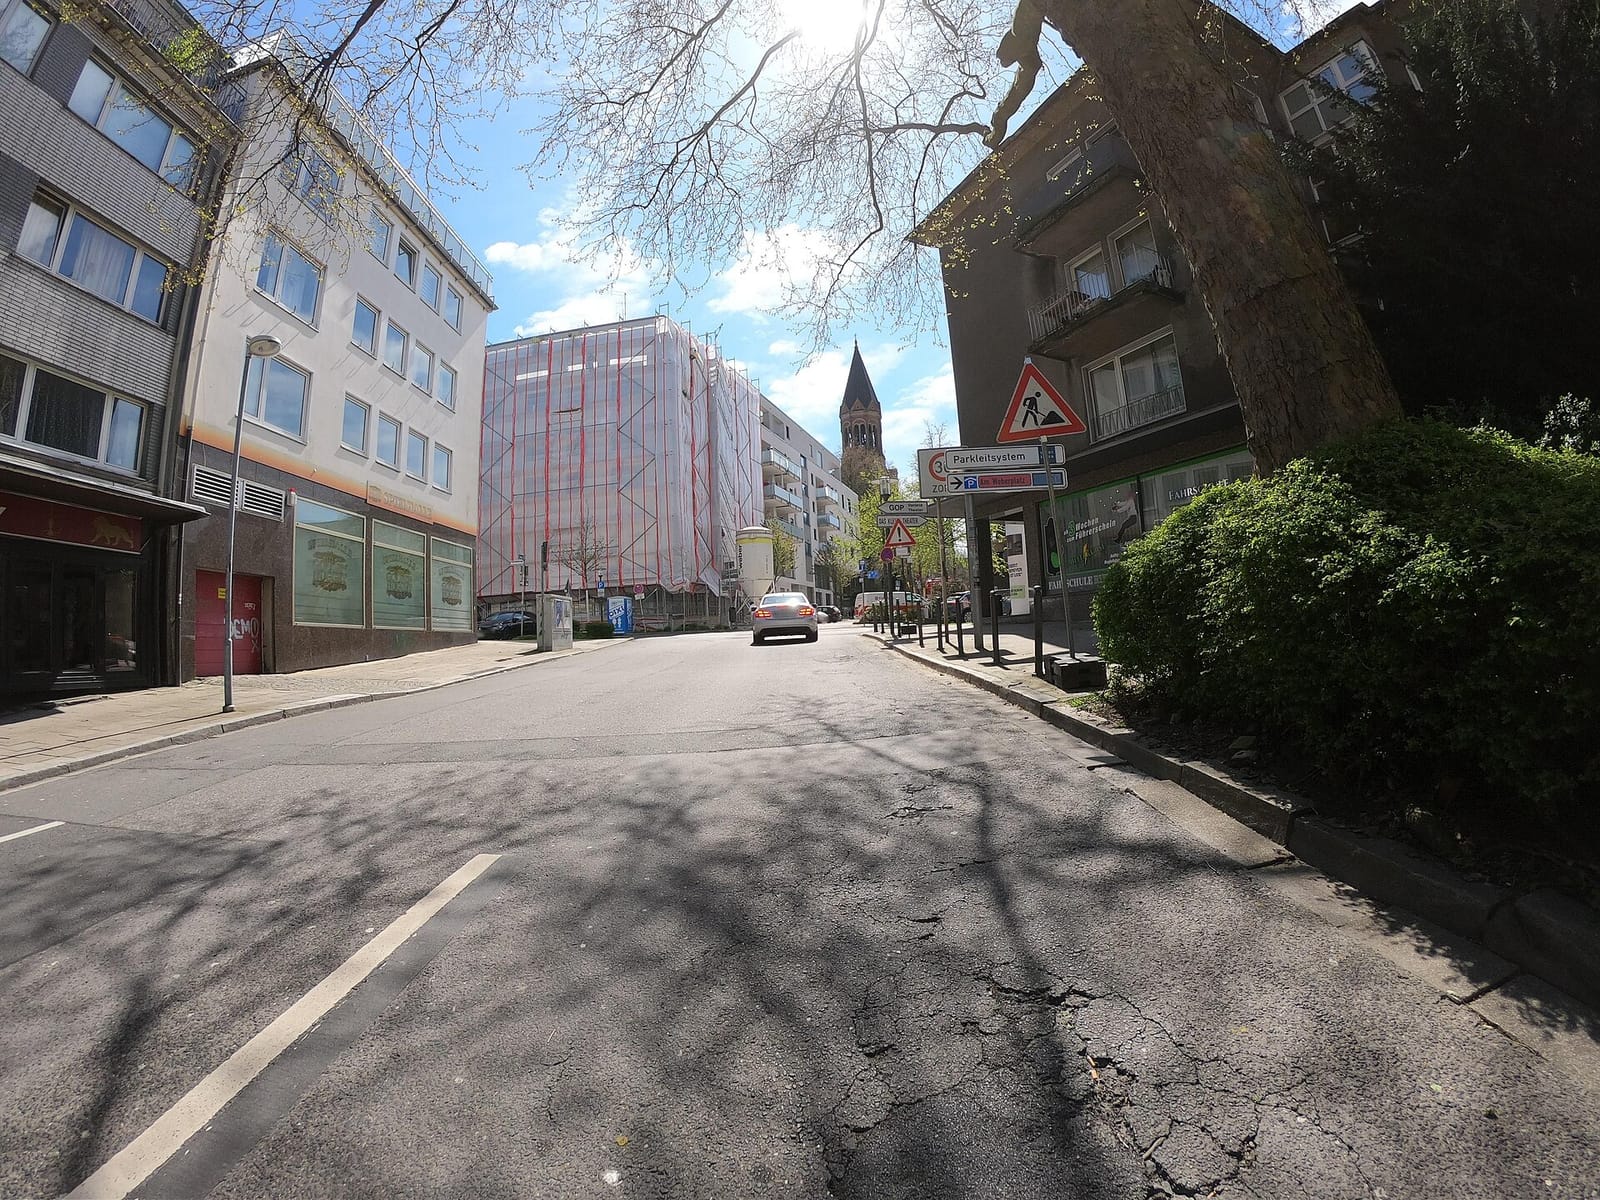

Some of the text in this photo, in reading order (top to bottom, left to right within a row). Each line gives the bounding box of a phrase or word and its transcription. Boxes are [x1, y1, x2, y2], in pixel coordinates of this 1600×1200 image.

[953, 453, 1026, 466] Parkleitsystem
[932, 484, 947, 493] ZO
[1075, 517, 1099, 531] Wochen
[1075, 519, 1116, 540] Führerschein
[1048, 576, 1093, 590] FAHSCHULE
